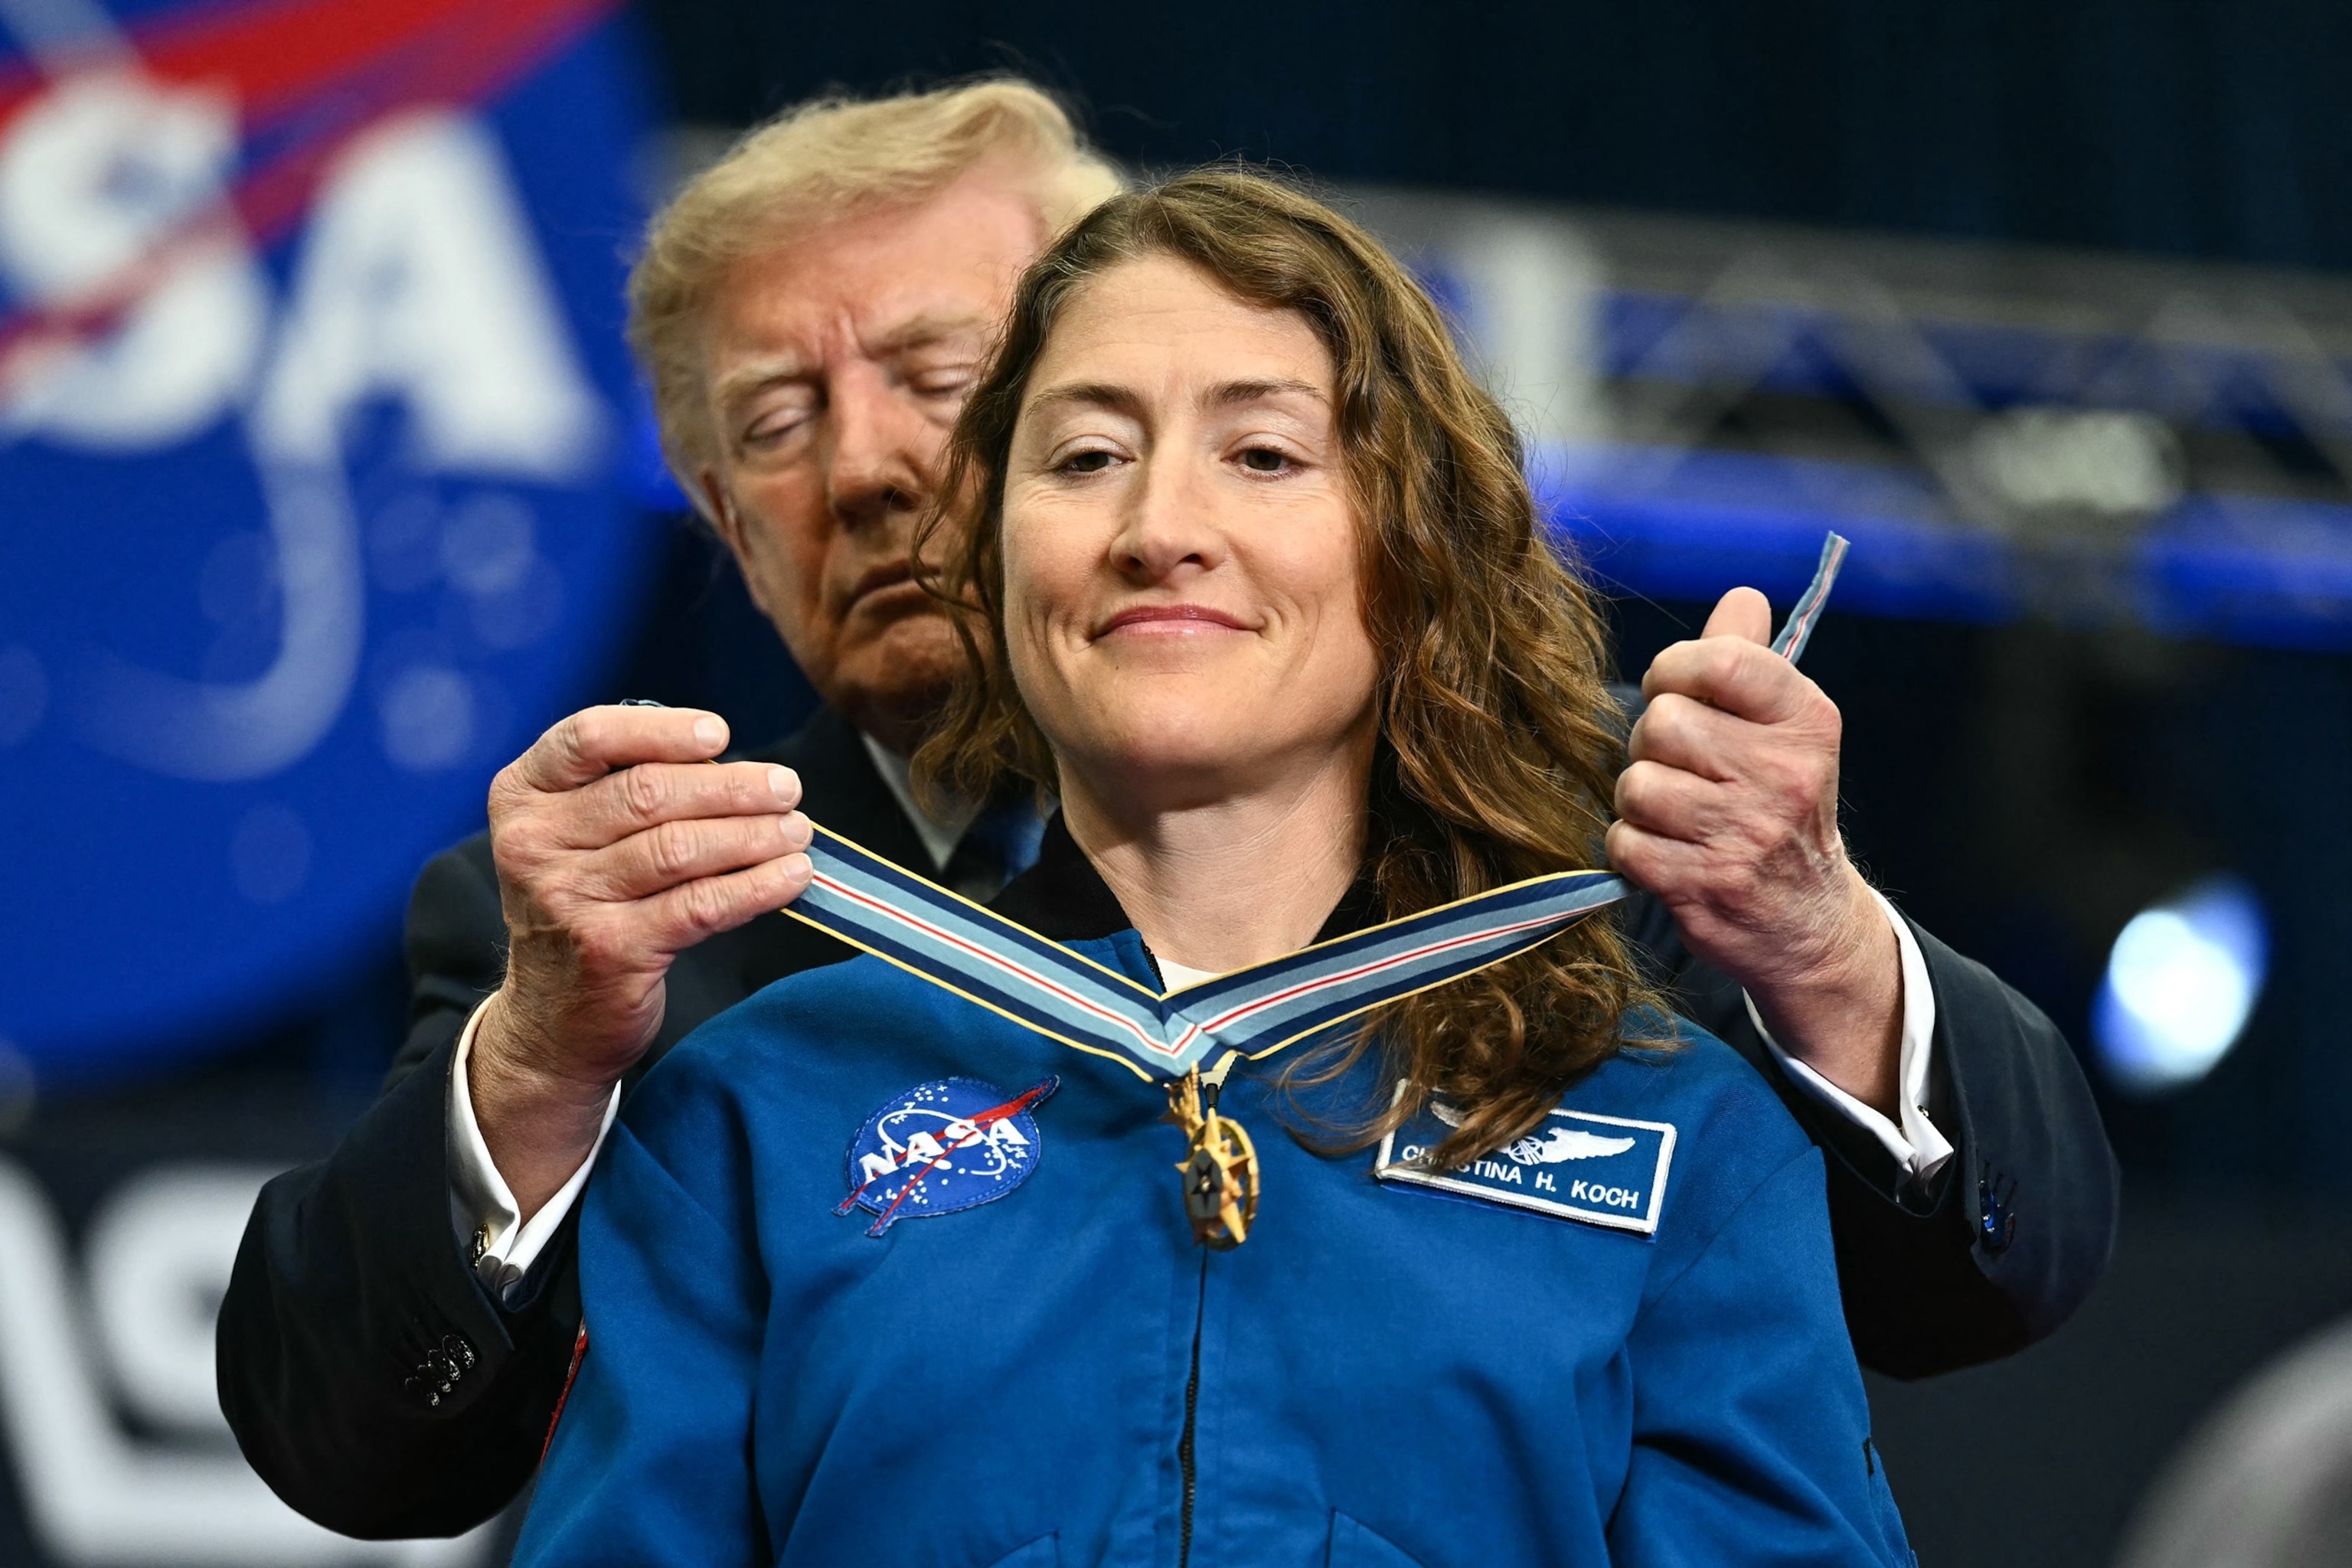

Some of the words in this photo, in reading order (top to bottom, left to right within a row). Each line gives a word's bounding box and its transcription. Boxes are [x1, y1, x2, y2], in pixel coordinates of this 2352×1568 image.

[859, 1118, 1030, 1184] NASA
[1402, 1145, 1522, 1184] CHSTINA
[1534, 1171, 1557, 1193] H.
[1570, 1179, 1640, 1210] KOCH
